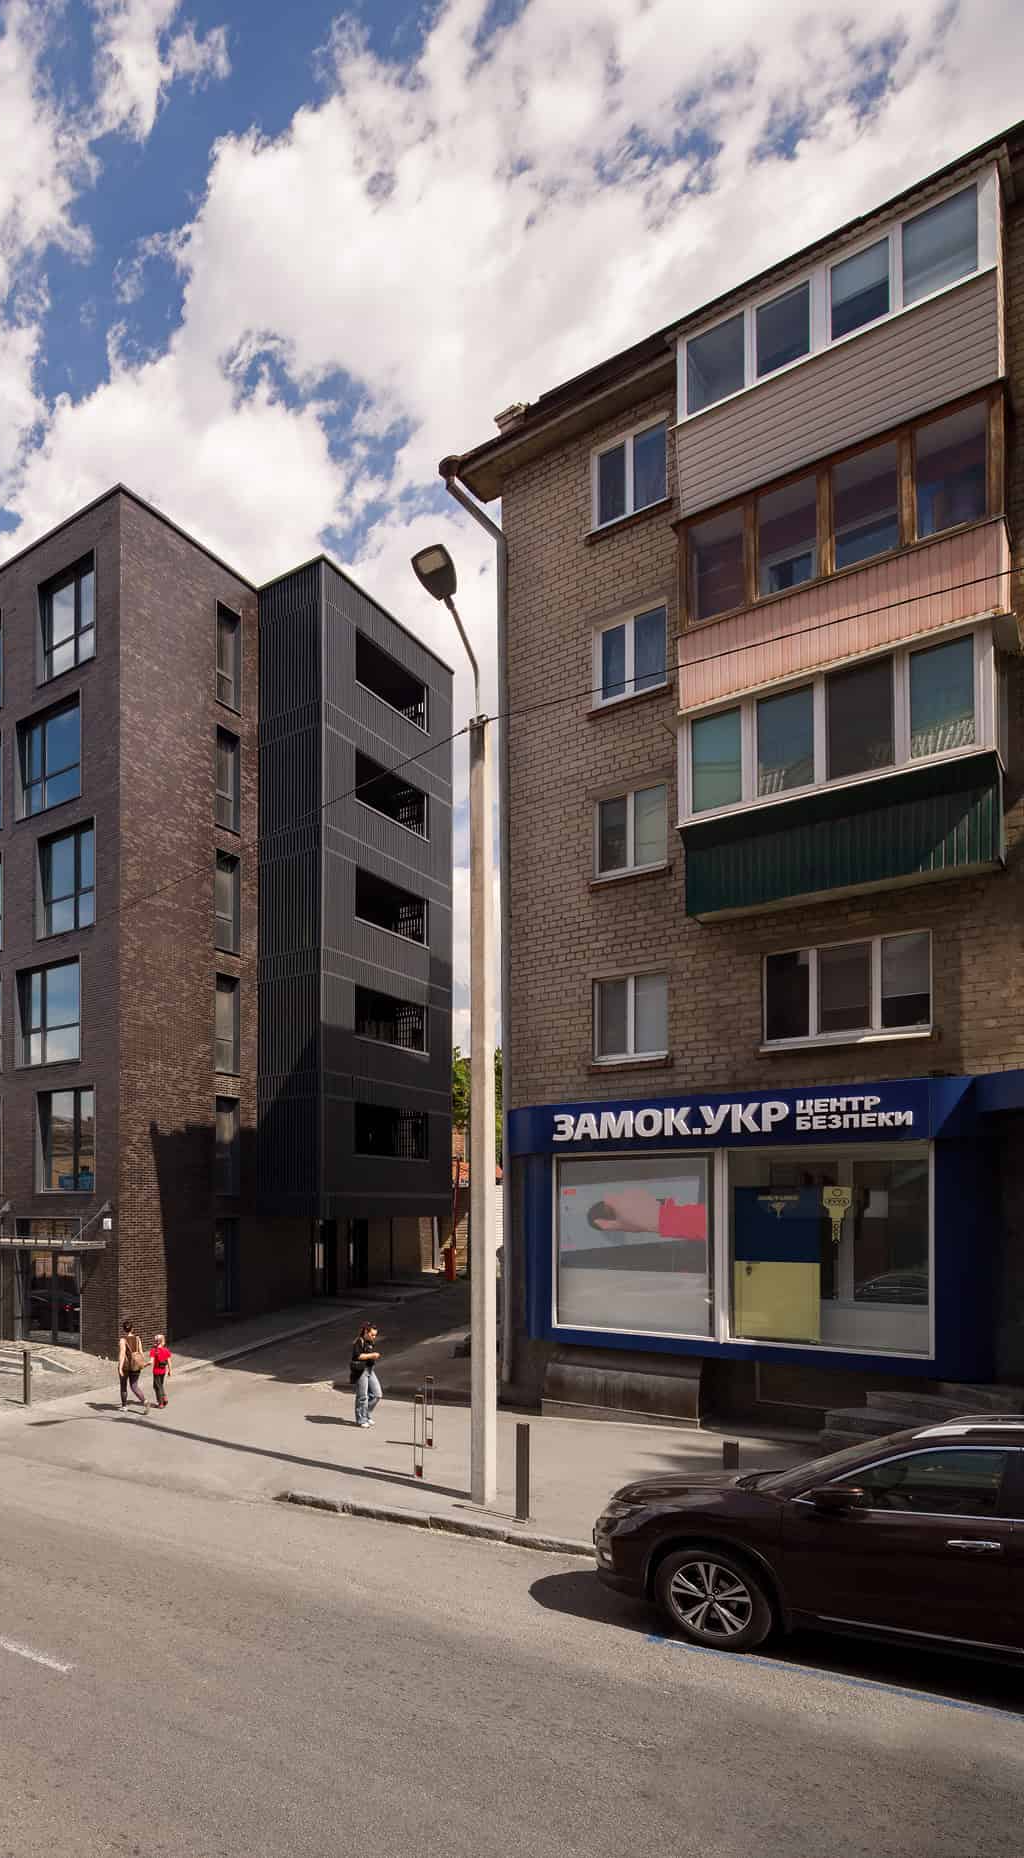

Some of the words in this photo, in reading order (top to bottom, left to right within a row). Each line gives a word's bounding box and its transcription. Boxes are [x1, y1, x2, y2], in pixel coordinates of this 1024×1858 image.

[796, 1096, 880, 1115] ЦЕНТР
[552, 1101, 789, 1141] ЗАМОК.УКР
[796, 1110, 913, 1130] БЕЗПЕКИ
